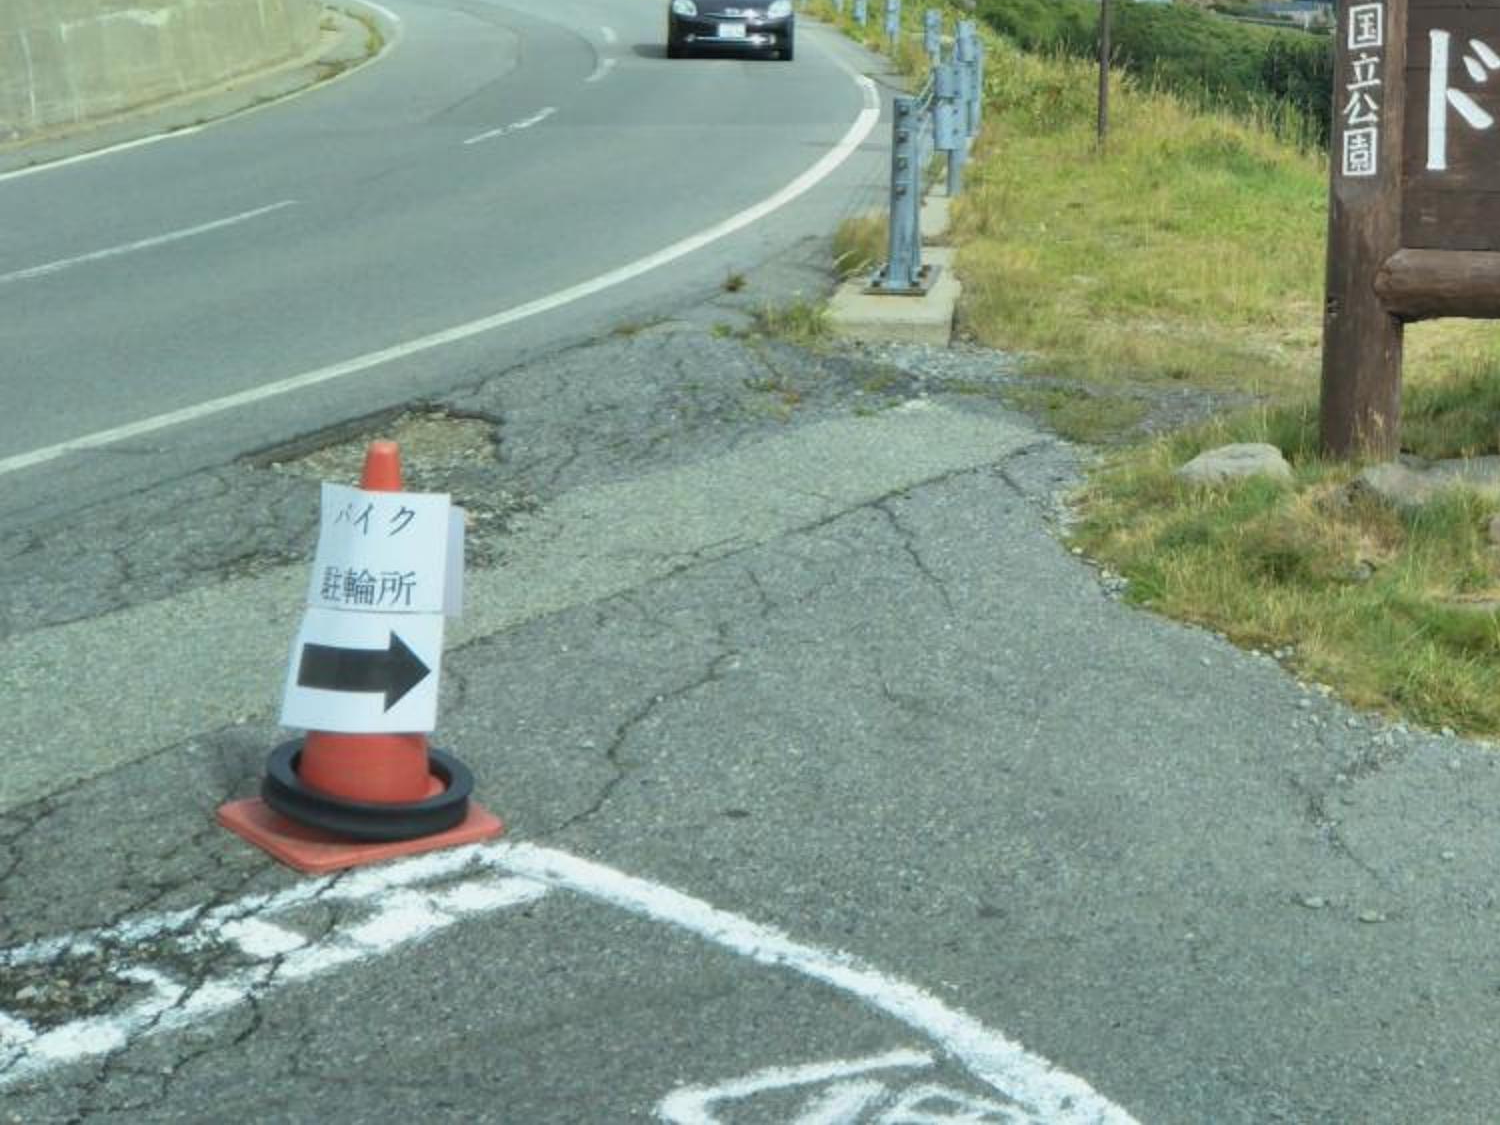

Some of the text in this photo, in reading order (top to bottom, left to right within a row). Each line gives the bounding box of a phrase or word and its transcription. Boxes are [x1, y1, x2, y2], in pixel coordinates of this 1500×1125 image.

[334, 502, 416, 537] バイク
[321, 566, 417, 606] 駐輪所
